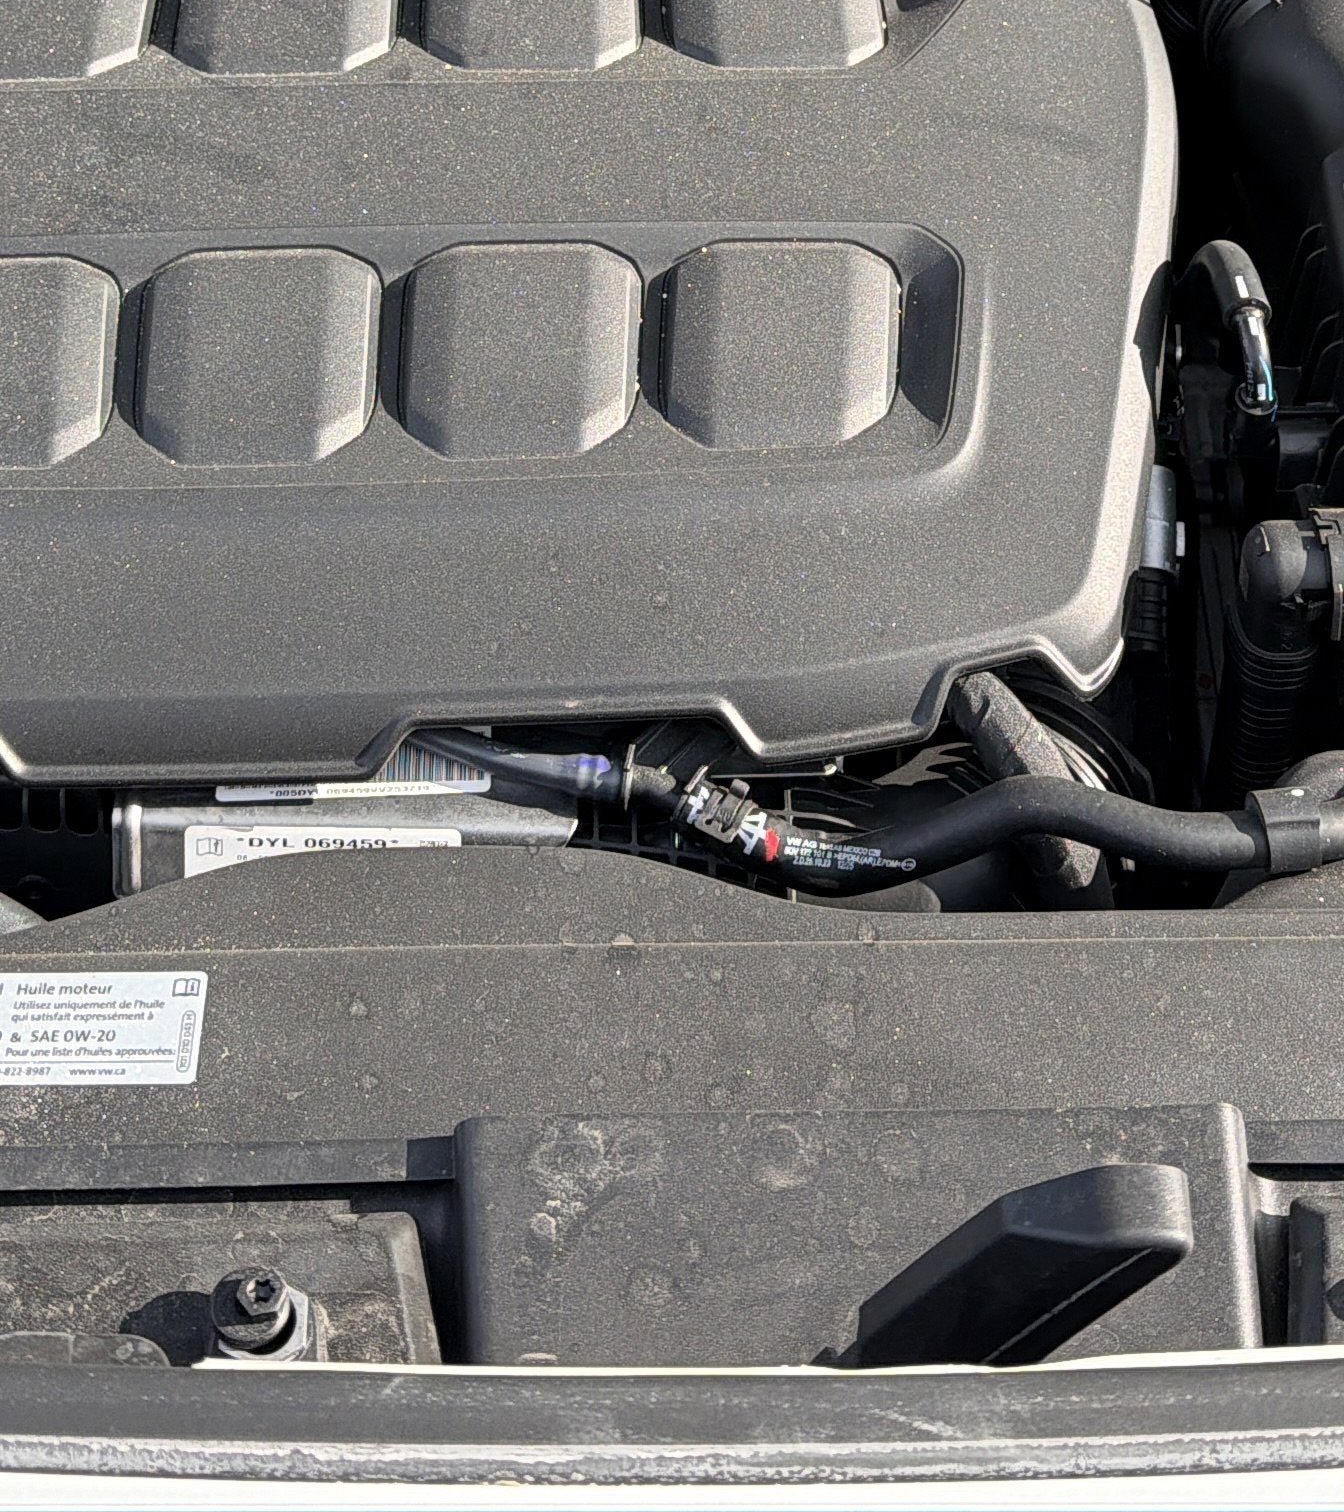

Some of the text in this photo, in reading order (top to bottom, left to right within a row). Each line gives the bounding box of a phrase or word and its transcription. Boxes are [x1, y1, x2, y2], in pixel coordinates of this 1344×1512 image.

[16, 982, 55, 995] Huile
[58, 984, 113, 995] moteur
[13, 1000, 51, 1010] Utilisez
[54, 1000, 116, 1011] uniquement
[119, 999, 131, 1009] de
[11, 1011, 154, 1023] qui satisfait expressément à
[10, 1032, 22, 1043] &
[30, 1029, 60, 1043] SAE
[64, 1029, 116, 1043] 0W-20
[6, 1048, 29, 1057] Pour
[31, 1049, 50, 1057] une
[52, 1047, 73, 1057] liste
